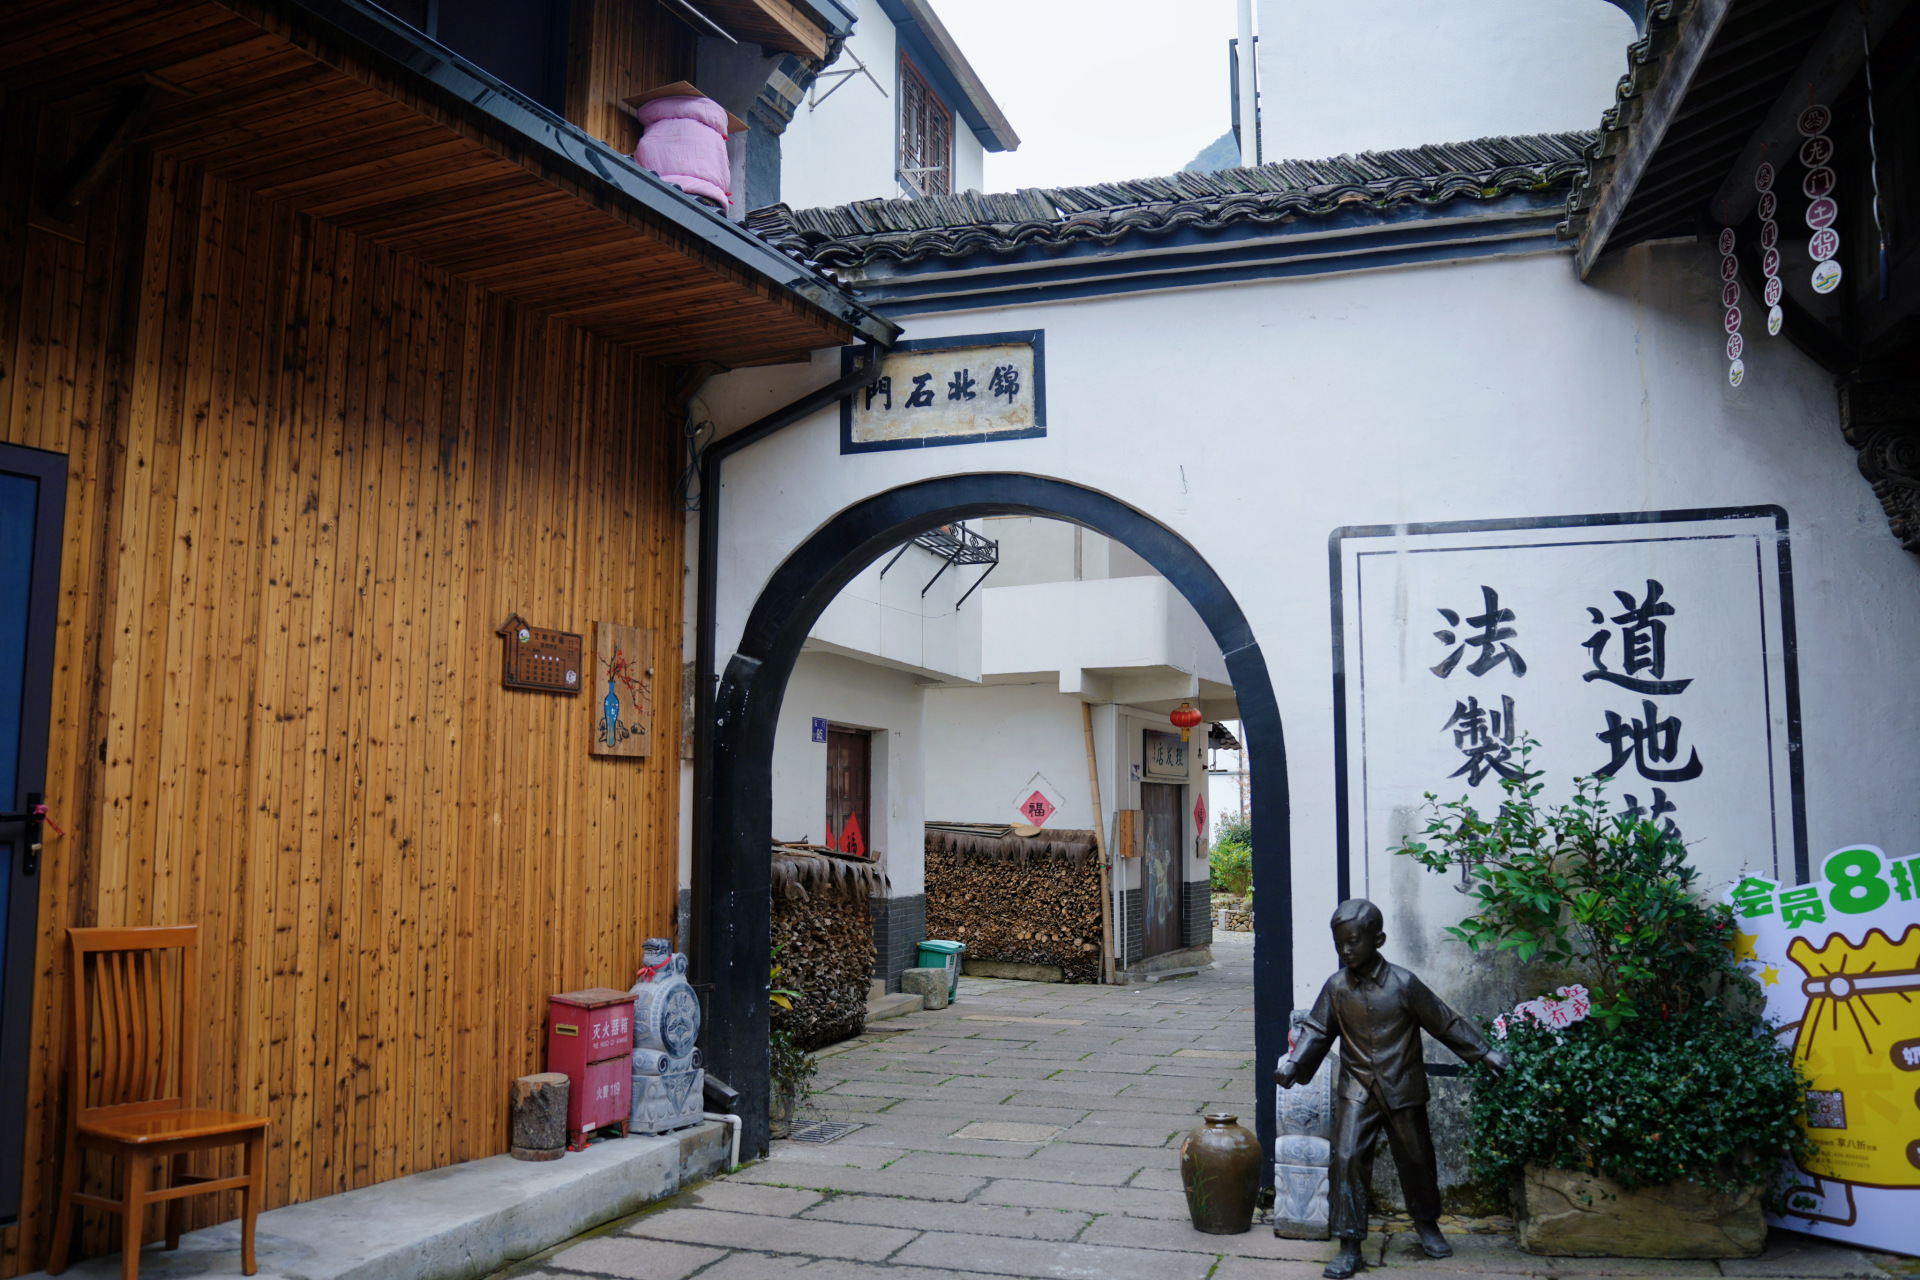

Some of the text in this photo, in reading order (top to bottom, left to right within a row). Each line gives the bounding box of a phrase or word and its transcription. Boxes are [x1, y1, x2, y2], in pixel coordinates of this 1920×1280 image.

[1806, 141, 1835, 260] 龙门土货
[1761, 197, 1780, 304] 龙门土货
[1723, 257, 1742, 357] 龙门土货
[1029, 803, 1045, 817] 福
[592, 1017, 629, 1041] 灭火器箱
[610, 1082, 620, 1096] 119
